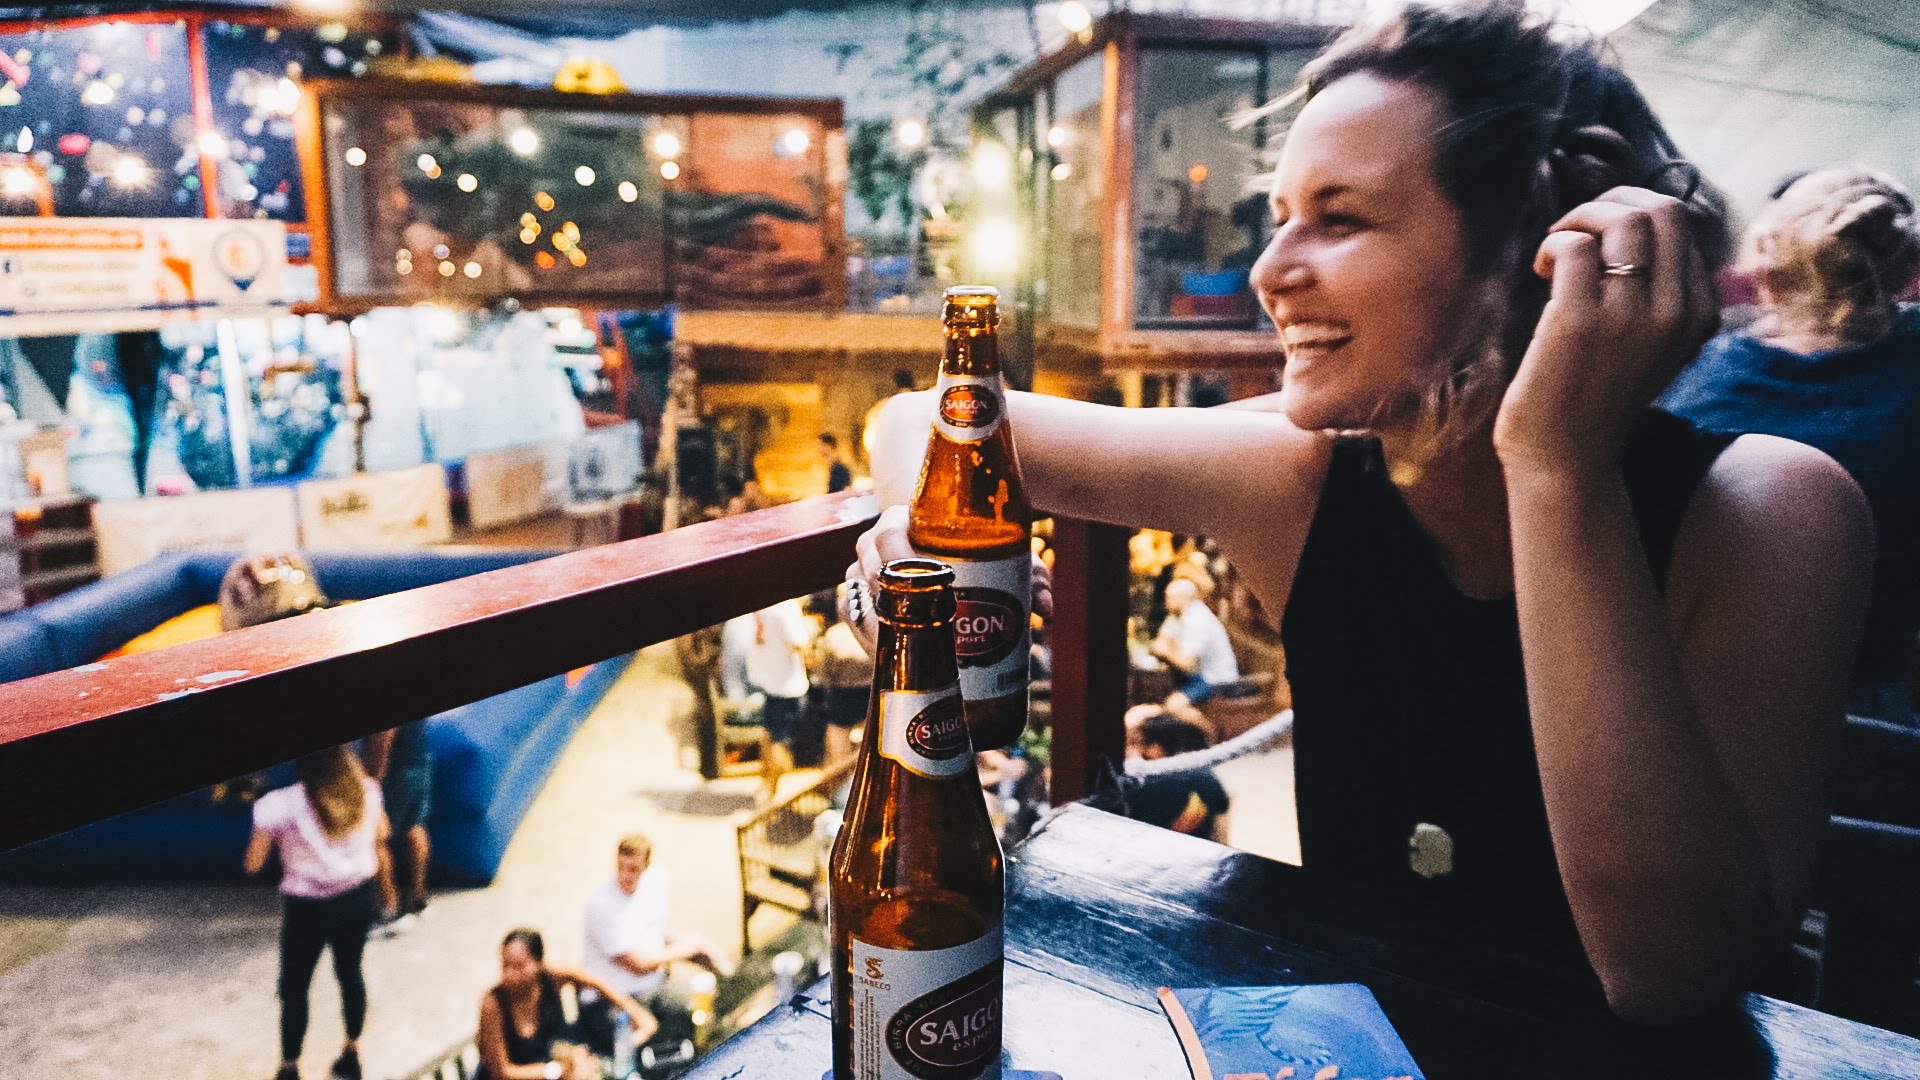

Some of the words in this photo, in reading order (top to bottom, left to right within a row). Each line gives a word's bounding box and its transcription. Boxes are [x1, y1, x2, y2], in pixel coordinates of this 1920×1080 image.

[945, 399, 987, 410] SAIGON
[955, 614, 1005, 634] GON
[956, 635, 986, 645] port
[920, 715, 963, 739] SAIGO
[859, 976, 891, 991] SABECO
[920, 996, 999, 1046] SAIGO
[953, 1023, 996, 1051] expor
